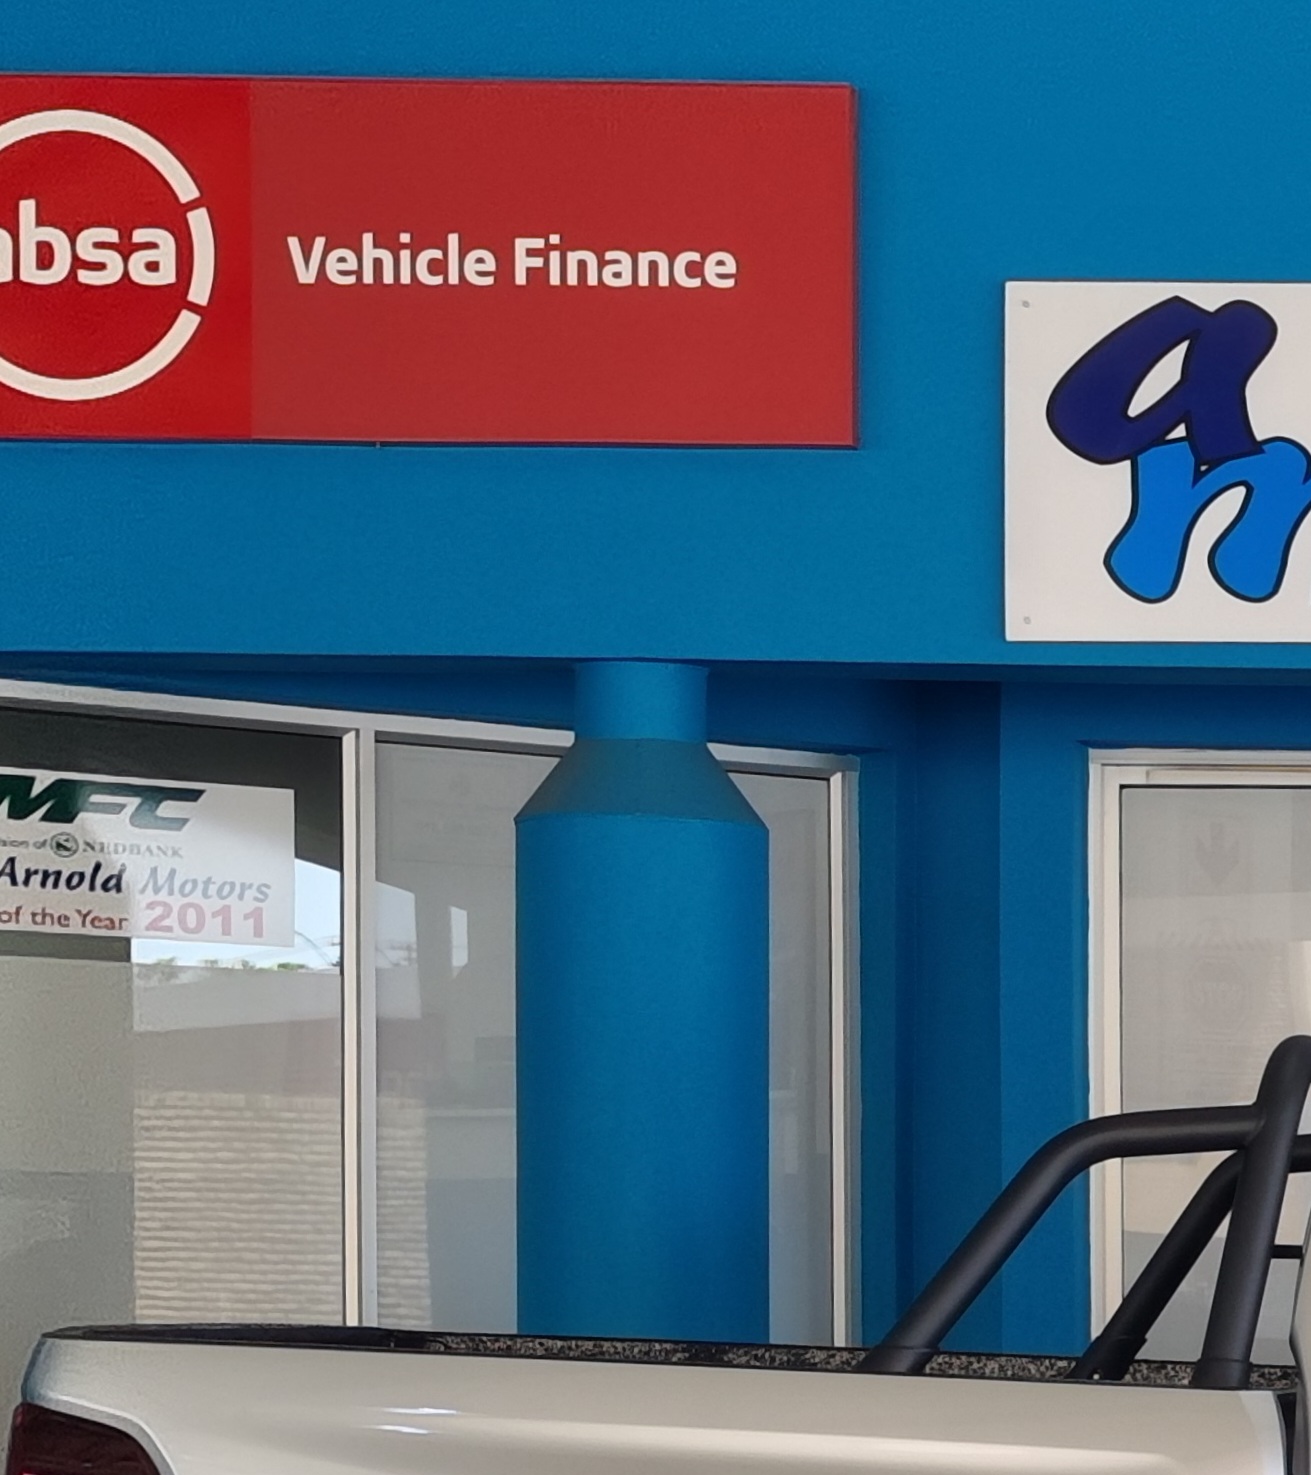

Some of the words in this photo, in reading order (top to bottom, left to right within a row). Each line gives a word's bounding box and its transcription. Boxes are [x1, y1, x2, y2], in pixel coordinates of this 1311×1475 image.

[0, 198, 177, 286] bsa
[287, 232, 497, 287] Vehicle
[514, 233, 738, 289] Finance
[0, 773, 206, 832] MFC
[0, 855, 126, 895] Arnold
[139, 865, 273, 904] Motors
[0, 905, 23, 925] of
[31, 906, 71, 928] the
[75, 908, 129, 931] Year
[144, 899, 265, 939] 2011
